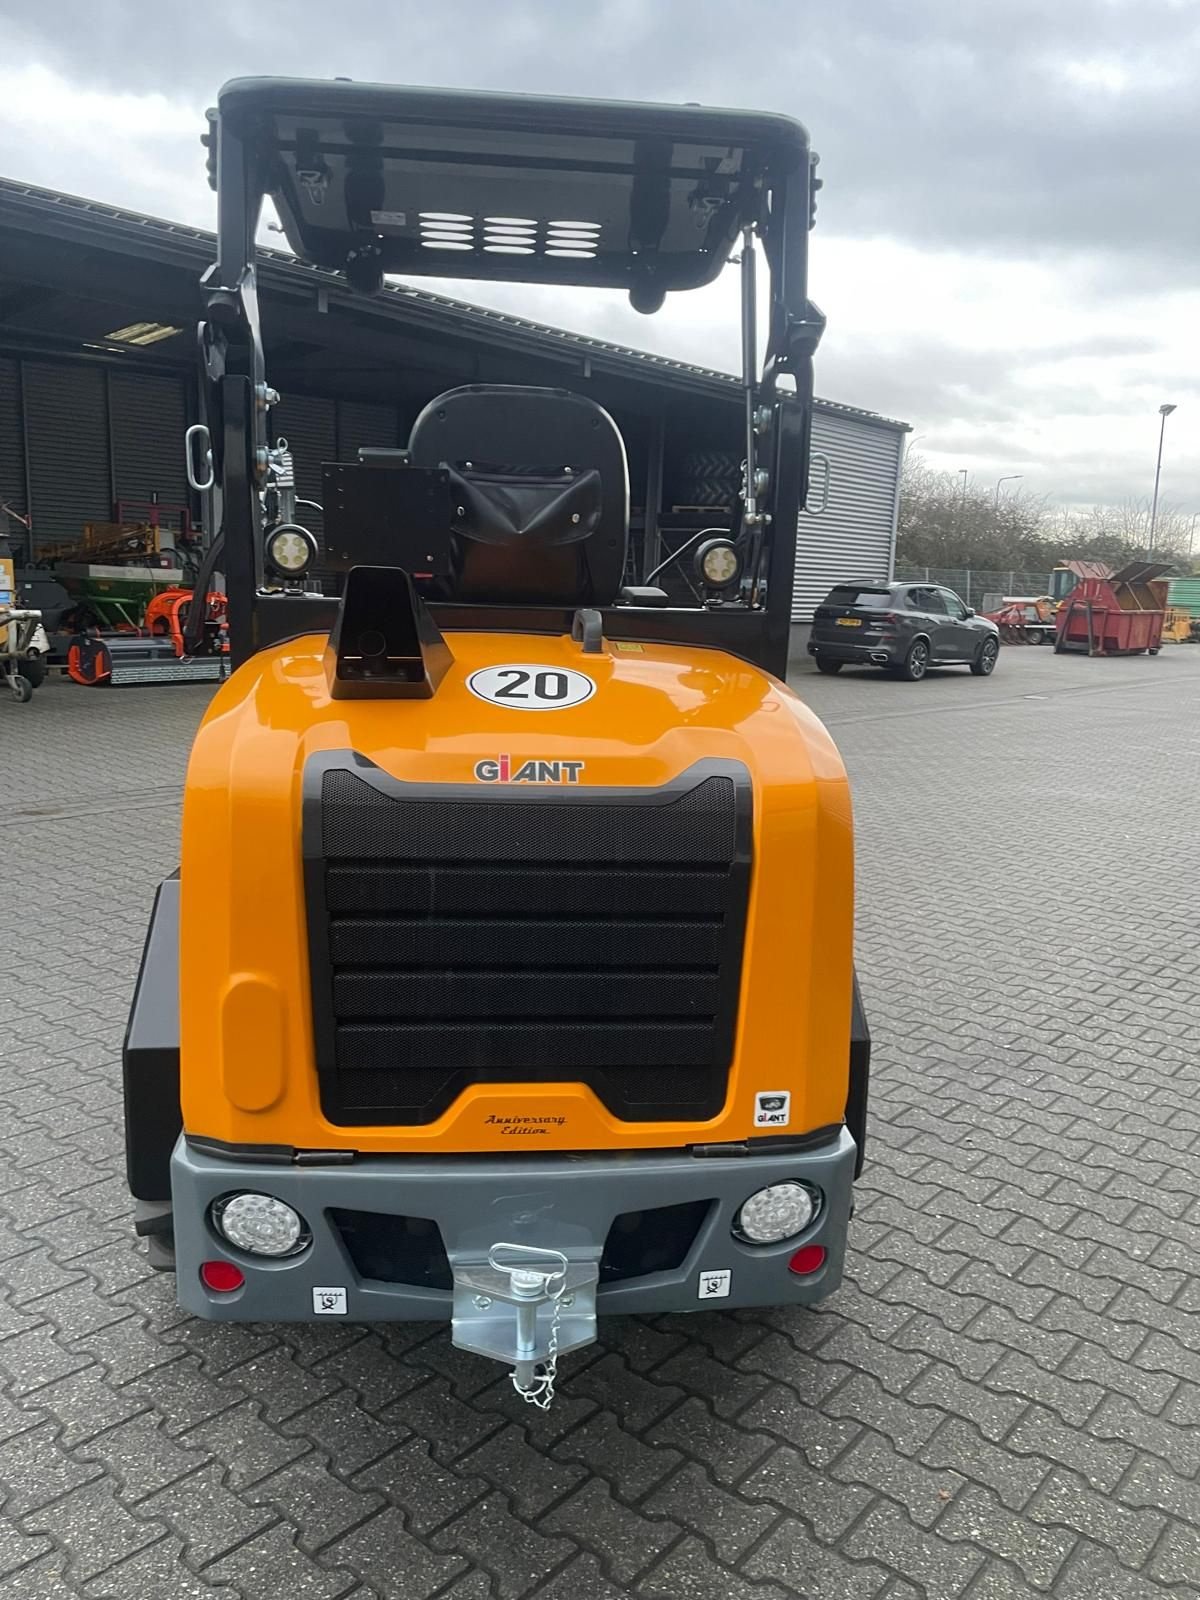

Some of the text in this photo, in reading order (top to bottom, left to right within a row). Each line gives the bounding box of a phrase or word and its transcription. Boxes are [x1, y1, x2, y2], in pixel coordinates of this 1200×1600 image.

[494, 670, 568, 700] 20
[484, 1114, 567, 1126] Anniversary
[500, 1126, 551, 1135] Edition
